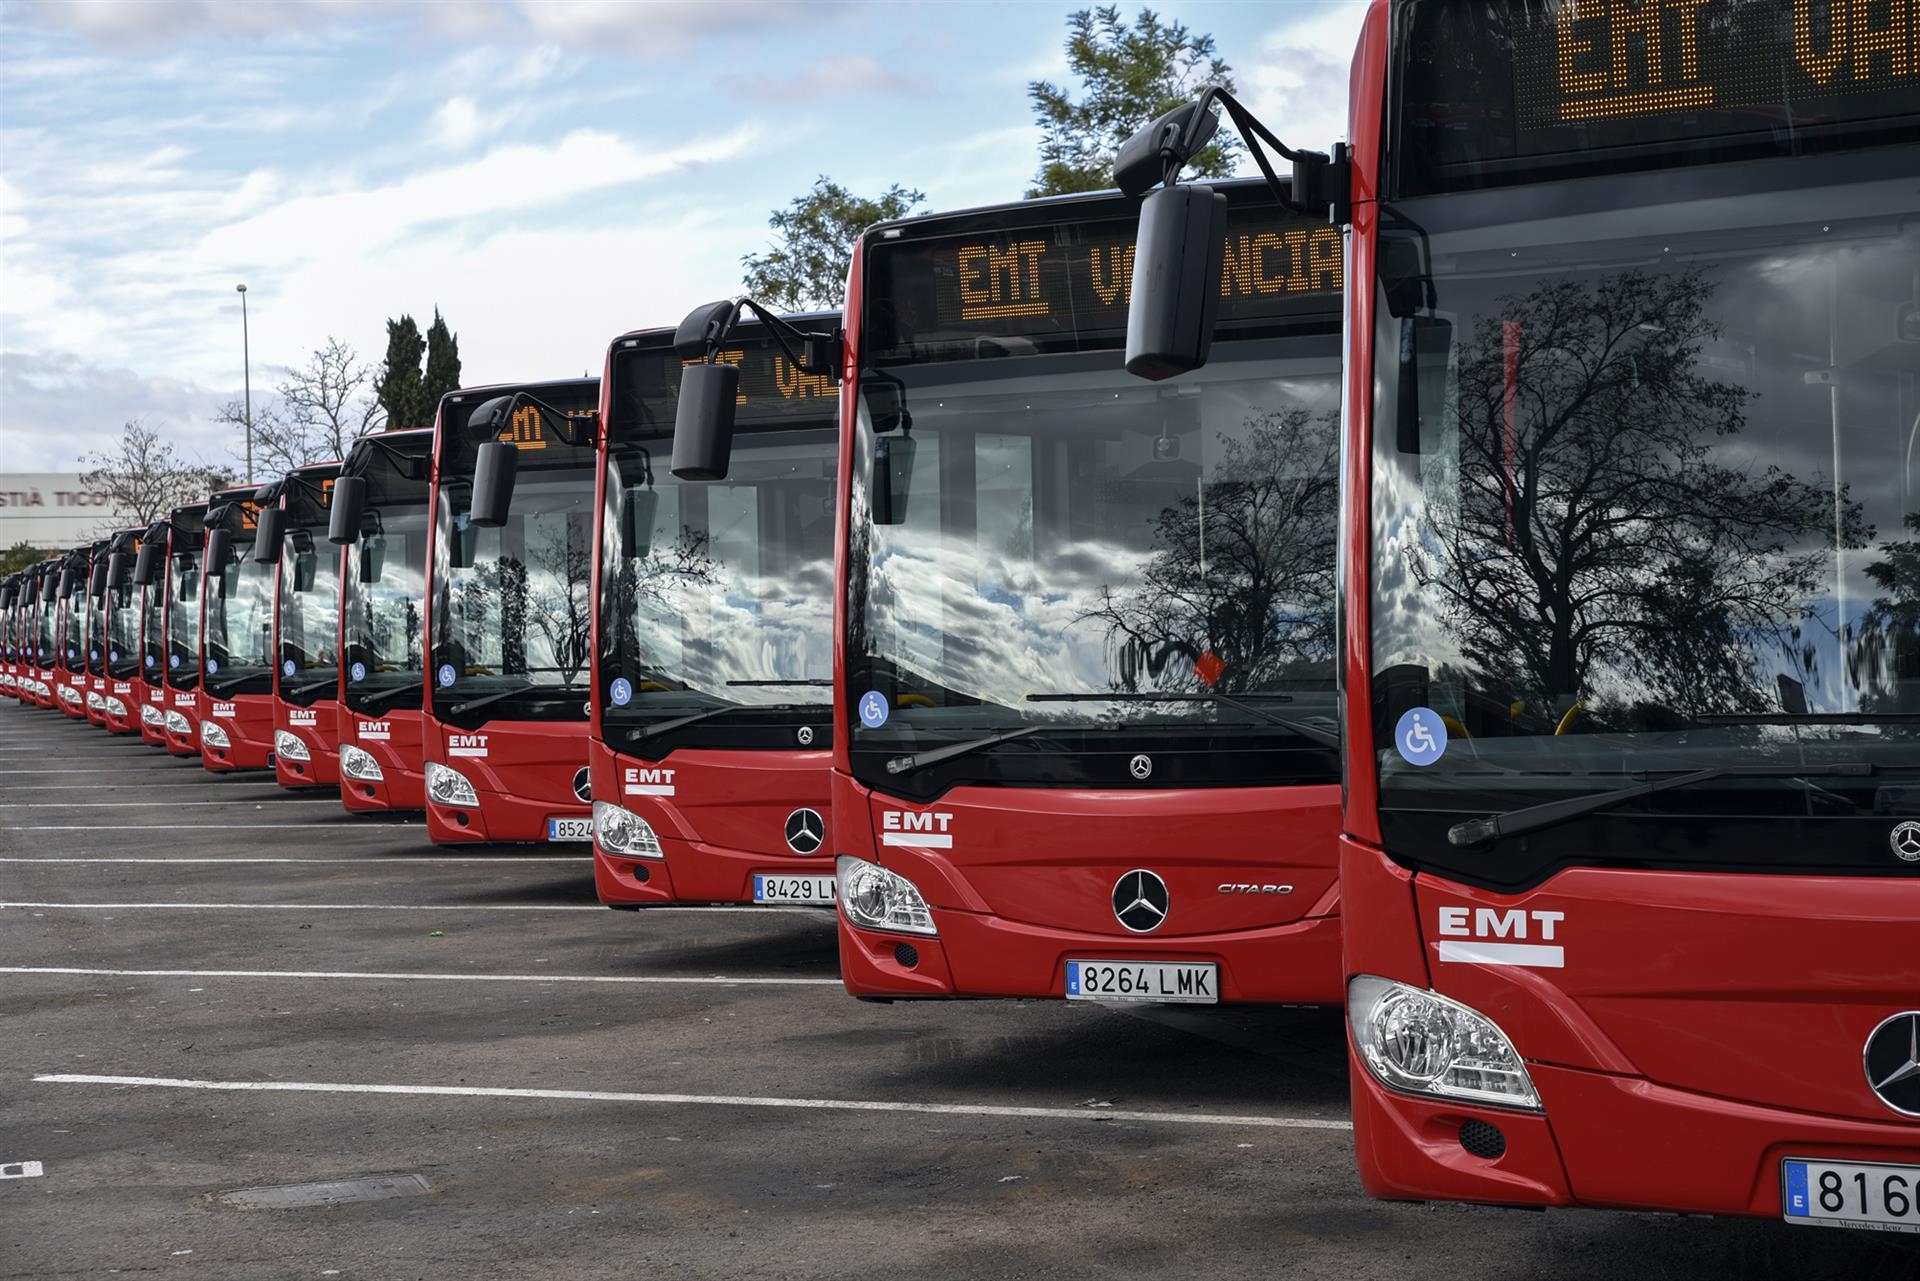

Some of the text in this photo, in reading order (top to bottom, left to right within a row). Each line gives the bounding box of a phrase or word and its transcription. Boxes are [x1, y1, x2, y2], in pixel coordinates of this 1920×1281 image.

[1558, 0, 1920, 93] EMT VA
[959, 240, 1046, 304] EMT
[113, 682, 132, 690] EMT
[175, 693, 196, 702] EMT
[212, 703, 236, 712] EMT
[289, 710, 317, 720] EMT
[358, 721, 391, 732] EMT
[448, 735, 489, 748] EMT
[624, 768, 676, 785] EMT
[558, 822, 593, 837] 8524
[883, 811, 954, 832] EMT
[766, 880, 812, 899] 8429
[1217, 883, 1294, 894] CITARO
[1438, 906, 1565, 941] EMT
[1084, 966, 1150, 994] 8264
[1159, 968, 1211, 996] LMK
[1793, 1170, 1920, 1218] E 816
